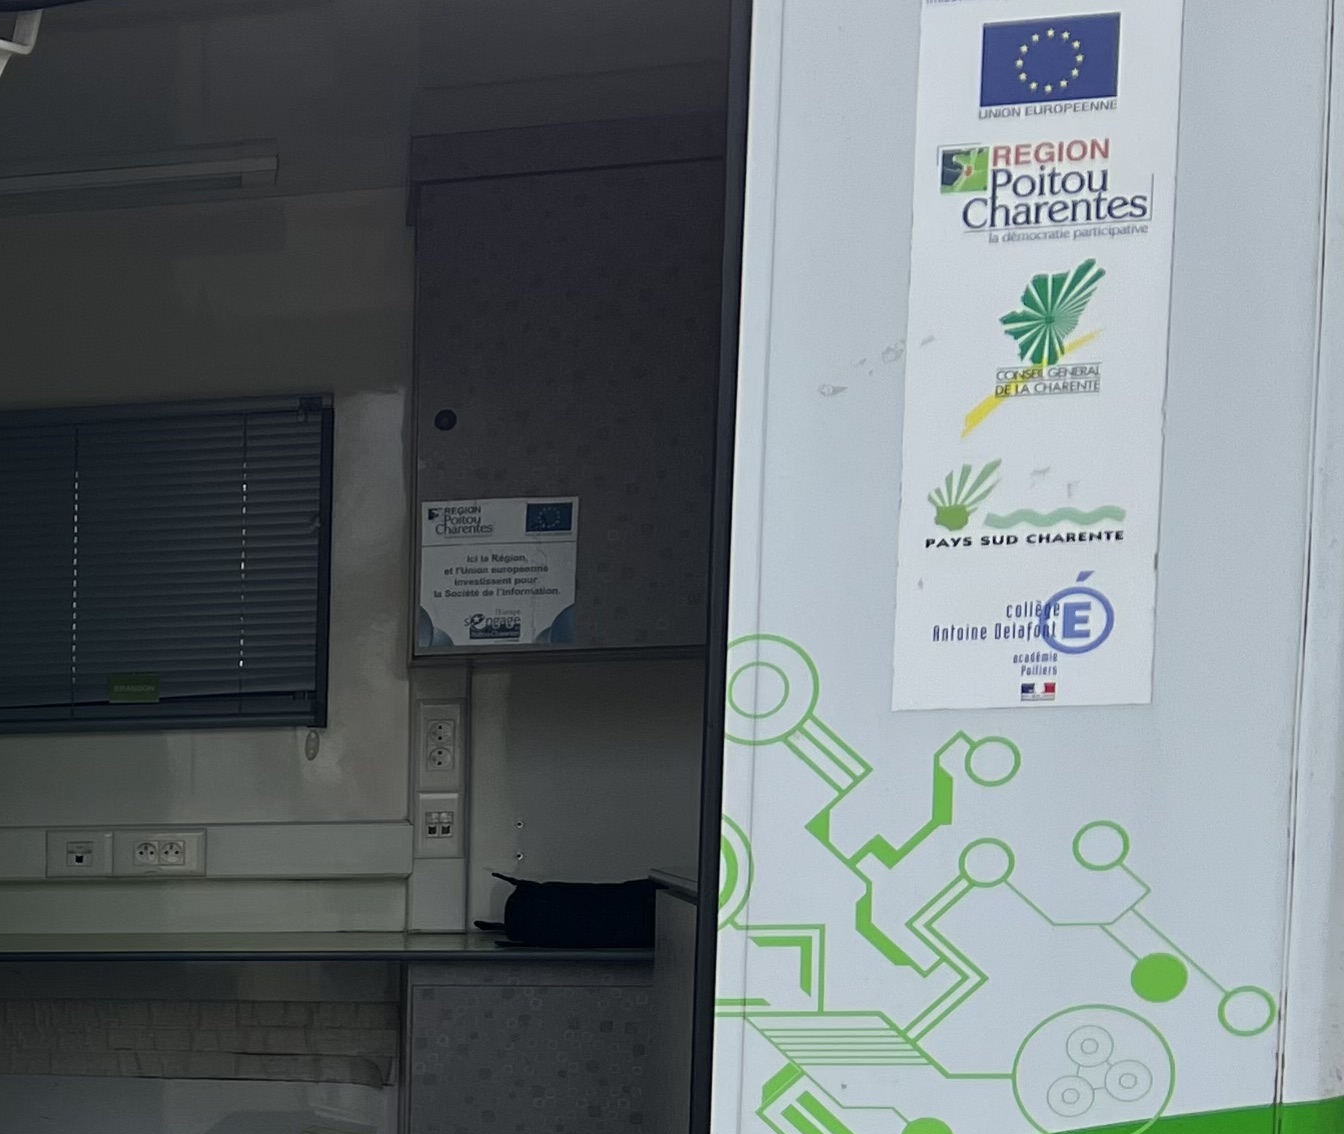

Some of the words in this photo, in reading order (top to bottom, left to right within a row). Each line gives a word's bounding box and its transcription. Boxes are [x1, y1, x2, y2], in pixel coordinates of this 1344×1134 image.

[978, 106, 1021, 121] UNION
[1025, 99, 1118, 117] EUROPEENNE
[992, 137, 1111, 168] REGION
[991, 164, 1109, 199] Poitou
[962, 192, 1149, 230] Charentes
[988, 231, 1000, 244] la
[1002, 228, 1071, 243] démocratie
[1073, 224, 1149, 240] participative
[995, 384, 1011, 397] DE
[1015, 382, 1030, 395] LA
[1034, 378, 1100, 394] CHARENTE
[444, 506, 482, 515] REGION
[435, 523, 493, 535] Charentes
[925, 536, 972, 549] PAYS
[980, 534, 1018, 546] SUD
[1026, 530, 1124, 545] CHARENTE
[514, 576, 539, 587] pour
[1006, 600, 1060, 621] collège
[932, 624, 988, 642] Antoine
[1013, 651, 1058, 664] académie
[1020, 664, 1058, 677] Poitiers
